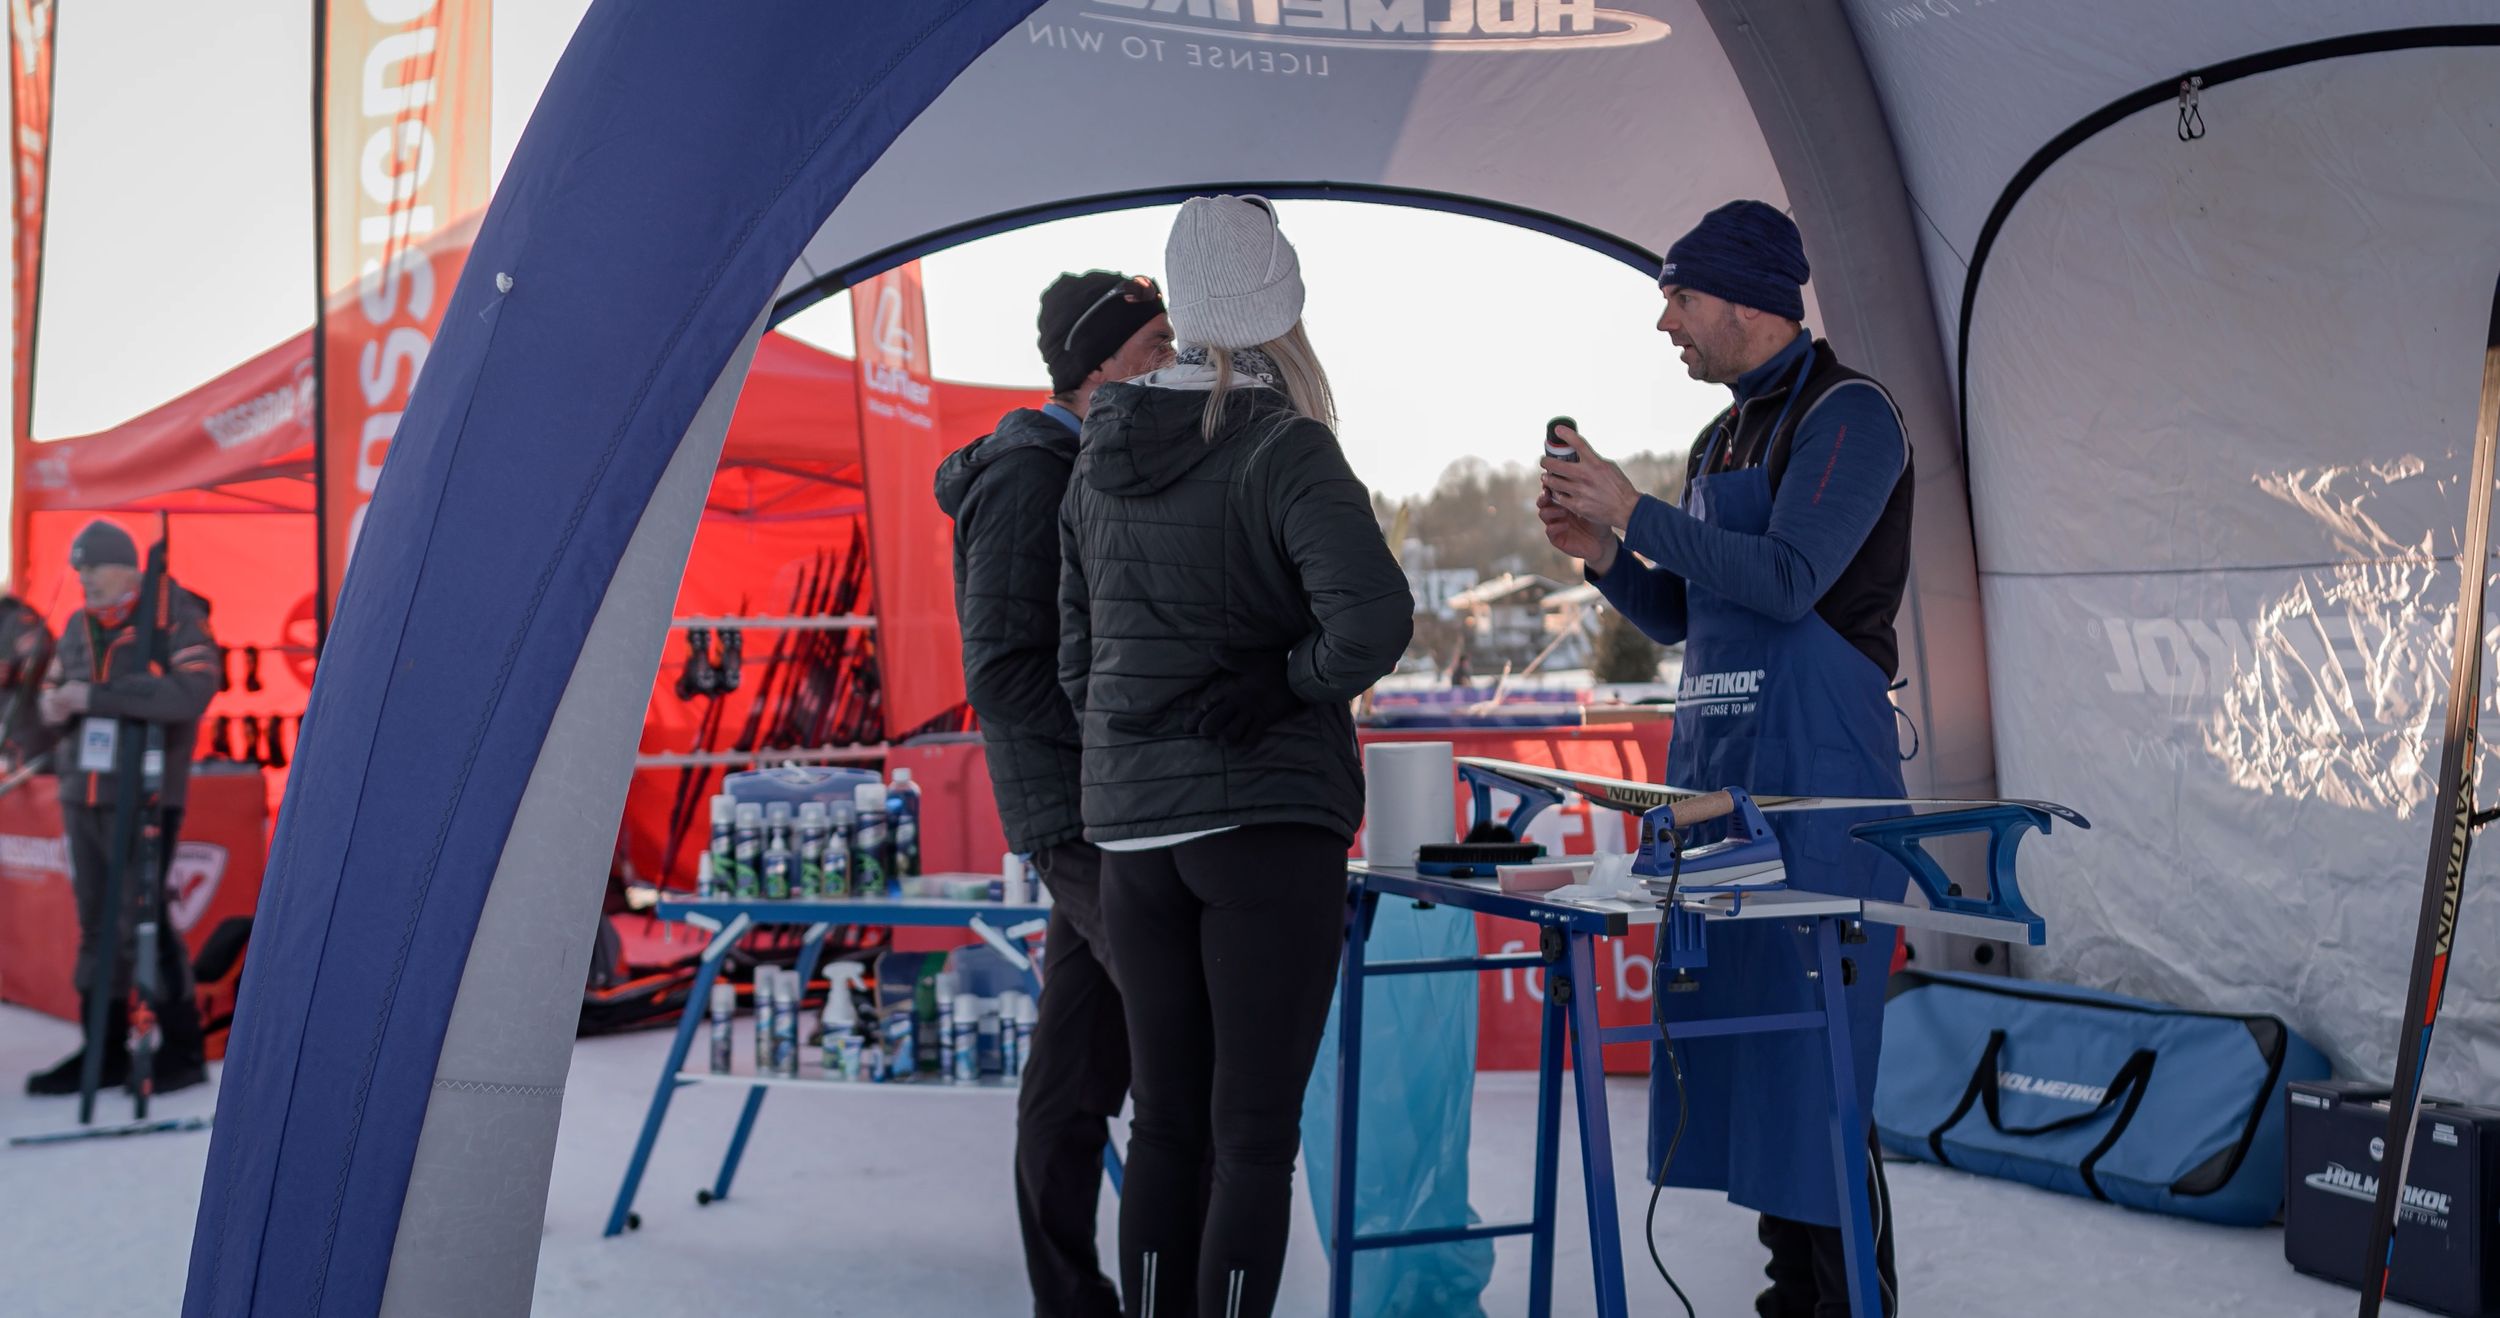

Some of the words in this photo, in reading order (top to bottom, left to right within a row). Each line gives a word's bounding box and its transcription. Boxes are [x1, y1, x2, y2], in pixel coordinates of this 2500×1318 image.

[1701, 704, 1729, 717] LICENSE
[1731, 703, 1741, 715] TO
[2435, 773, 2473, 948] SALOMON
[2430, 1215, 2449, 1230] WIN
